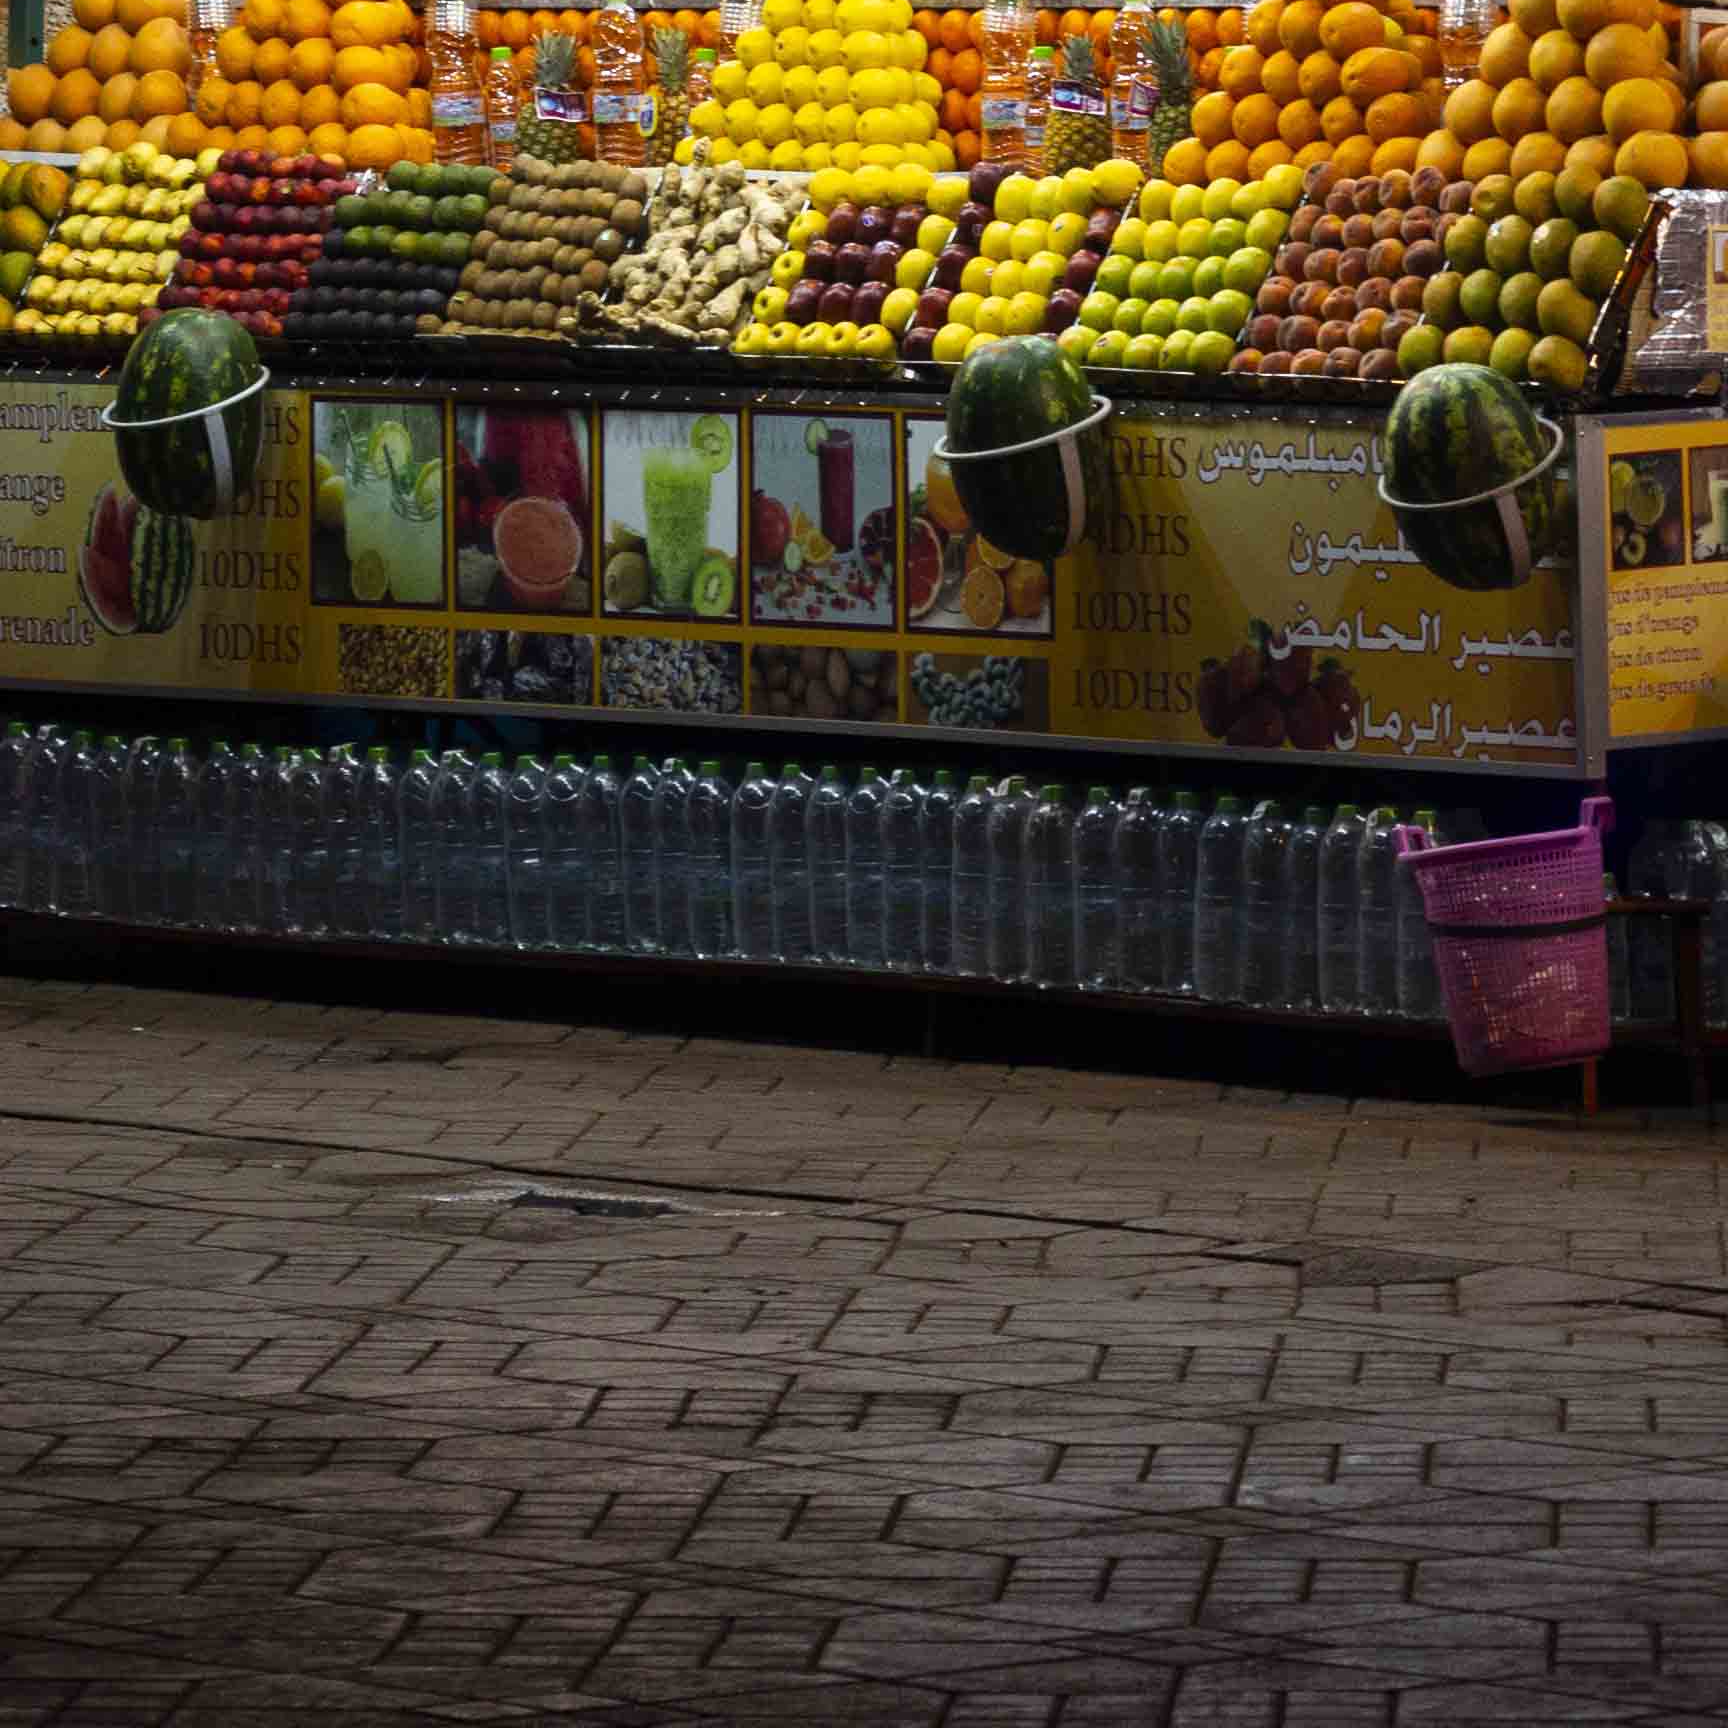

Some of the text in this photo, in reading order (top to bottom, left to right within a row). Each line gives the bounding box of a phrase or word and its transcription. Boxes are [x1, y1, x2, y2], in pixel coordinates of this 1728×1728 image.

[200, 549, 300, 592] 10DHS
[1072, 590, 1193, 637] 10DHS
[1072, 668, 1193, 713] 10DHS
